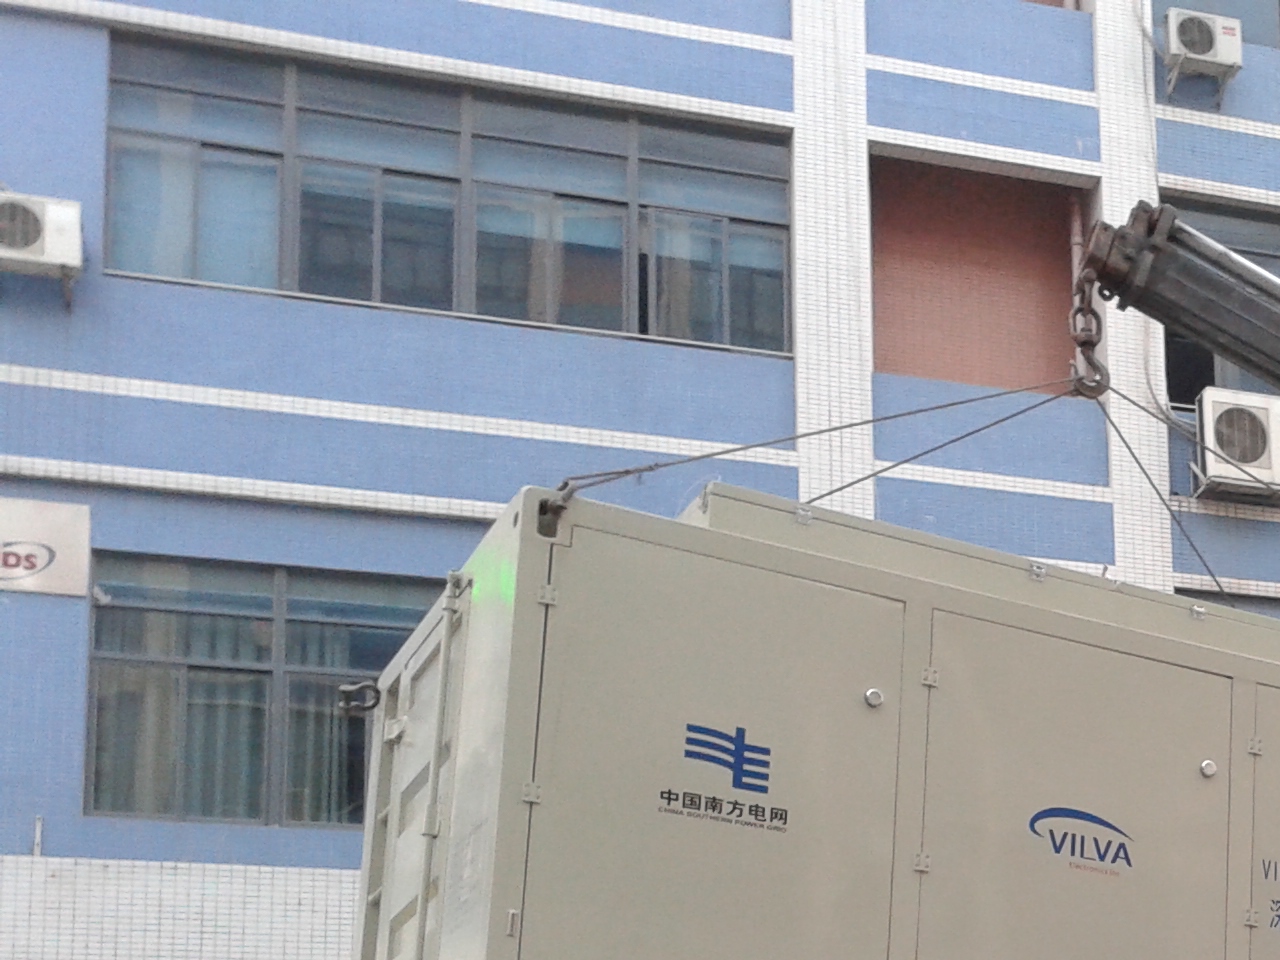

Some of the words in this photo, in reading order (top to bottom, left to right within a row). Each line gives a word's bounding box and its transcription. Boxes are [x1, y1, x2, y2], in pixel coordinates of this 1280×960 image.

[658, 806, 685, 816] CHINA
[686, 811, 733, 825] SOUTHERN
[734, 819, 765, 829] POWER
[660, 789, 788, 825] 中国南方电网
[1049, 829, 1133, 868] VILVA
